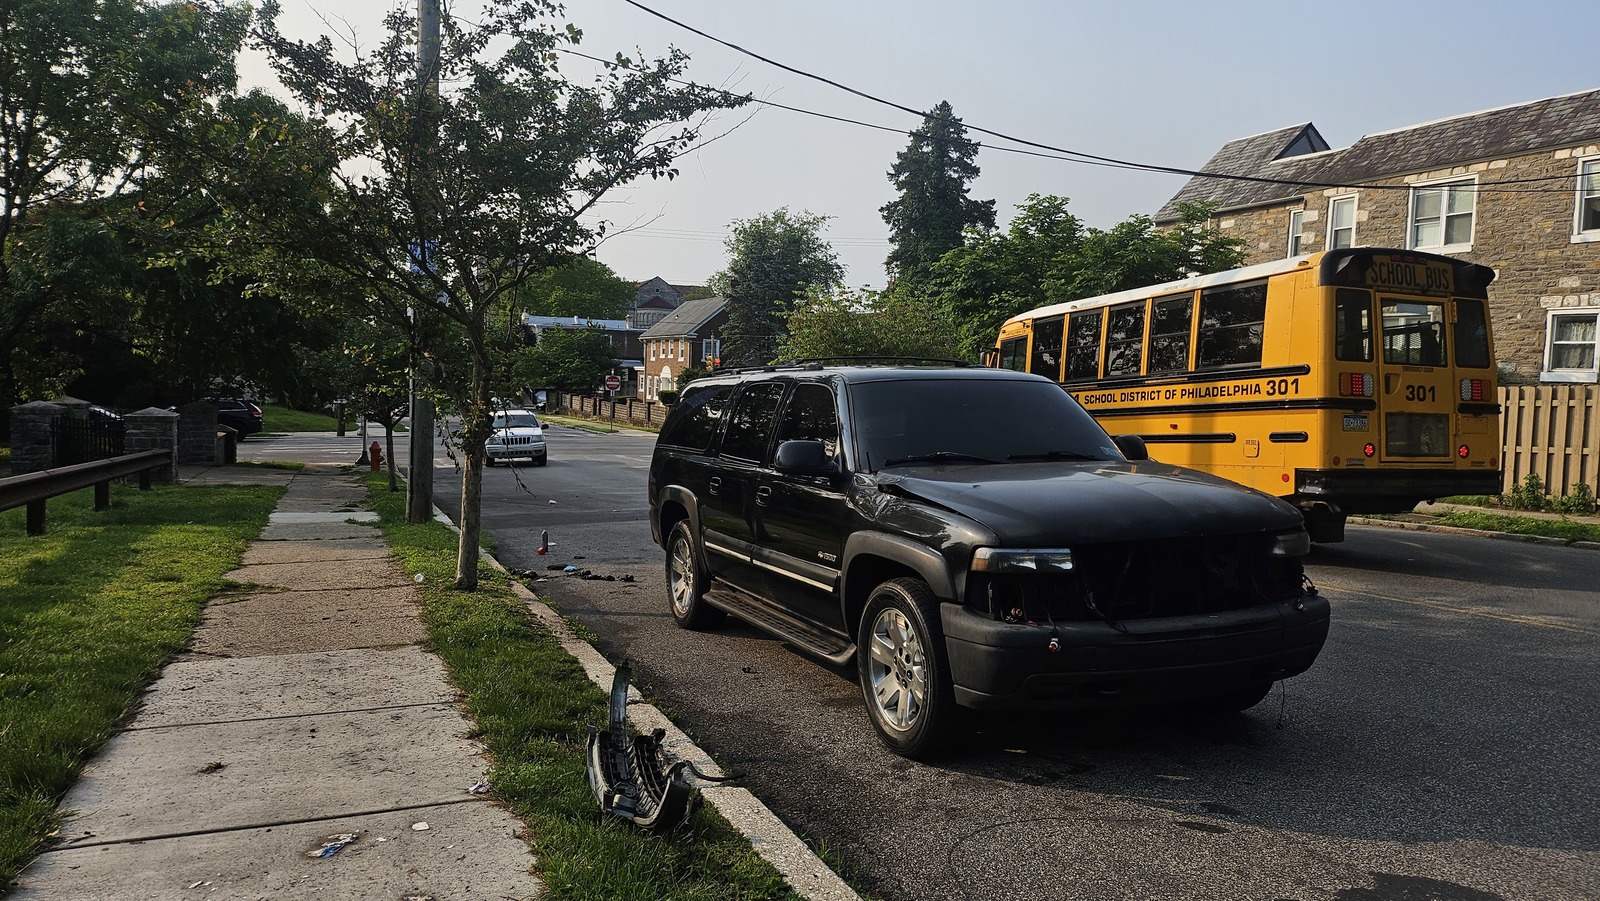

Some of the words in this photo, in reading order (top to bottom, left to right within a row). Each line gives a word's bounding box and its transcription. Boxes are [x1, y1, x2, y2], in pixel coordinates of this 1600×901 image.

[1371, 261, 1420, 287] SCHOOL
[1425, 264, 1450, 290] BUS
[1084, 393, 1117, 404] SCHOOL
[1120, 390, 1161, 402] DISTRICT
[1164, 389, 1177, 400] OF
[1180, 383, 1262, 399] PHILADELPHIA
[1266, 378, 1299, 396] 301
[1405, 384, 1436, 402] 301
